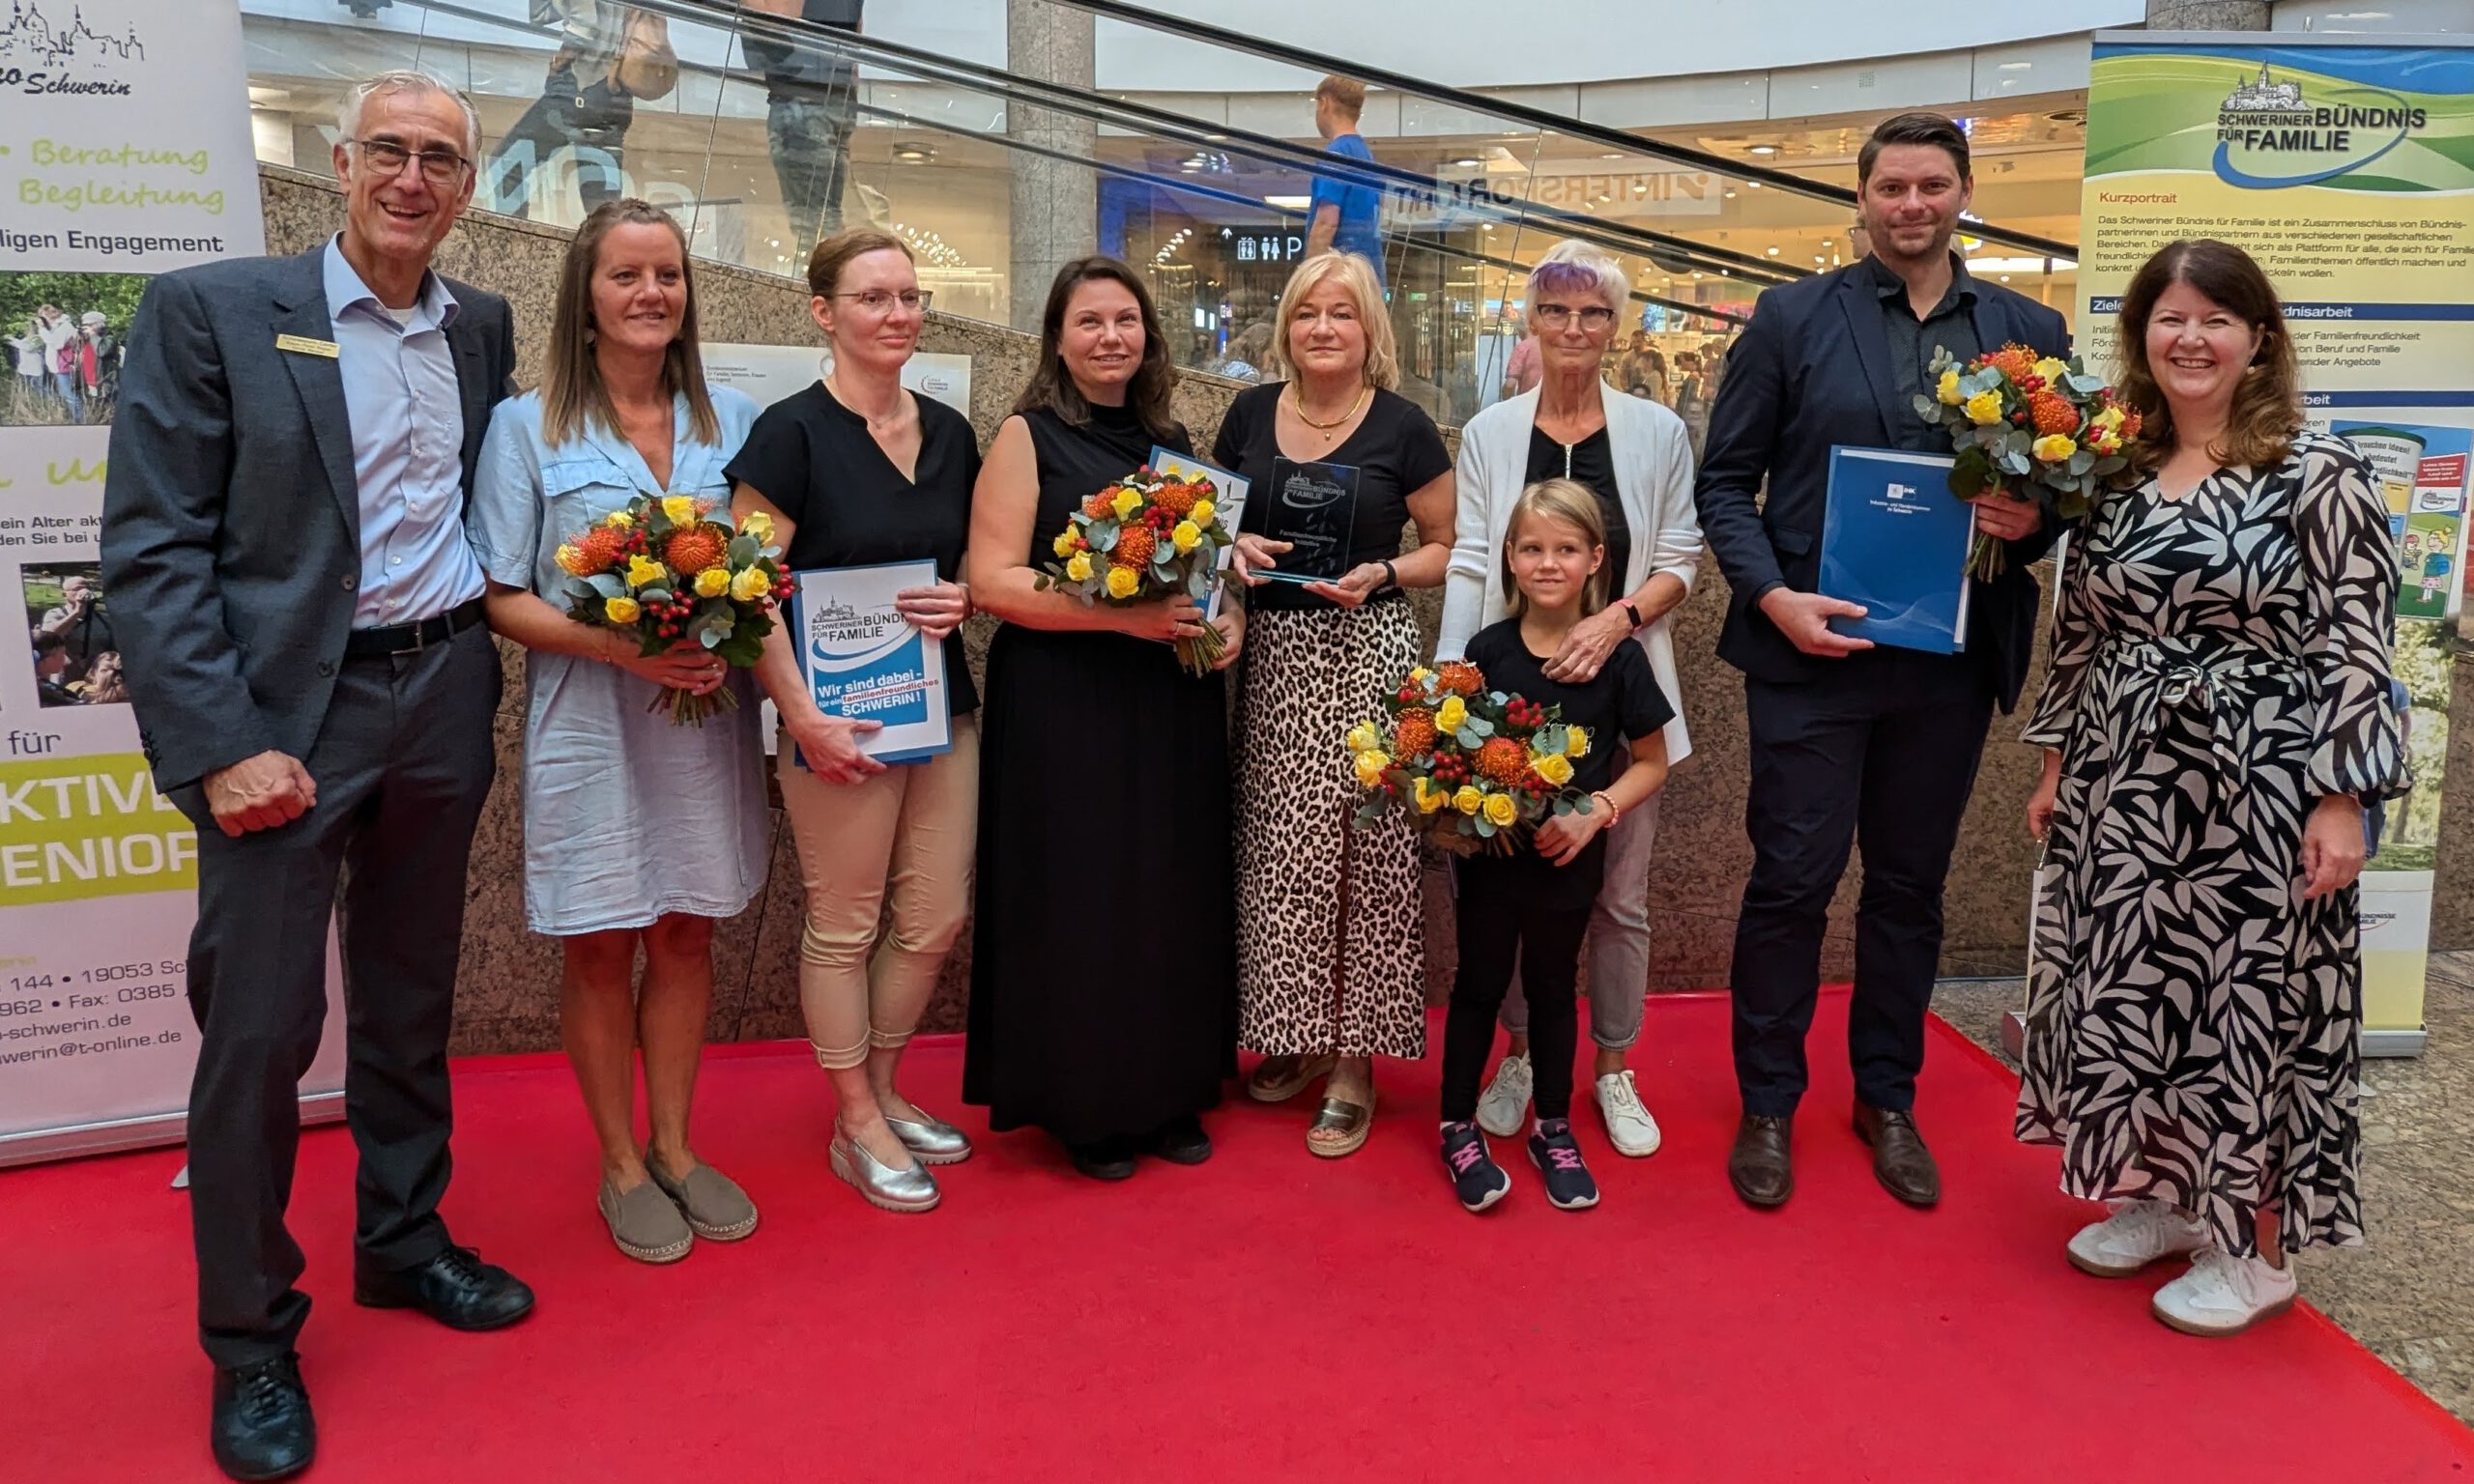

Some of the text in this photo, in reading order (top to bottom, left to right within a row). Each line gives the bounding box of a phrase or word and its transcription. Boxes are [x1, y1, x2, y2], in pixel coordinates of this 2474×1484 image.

[23, 72, 131, 96] Schwerin
[2218, 103, 2427, 128] SCHWERINER BÜNDNIS
[2217, 127, 2350, 151] FÜR FAMILIE
[31, 138, 210, 175] Beratung
[18, 178, 225, 215] Begleitung
[2099, 192, 2177, 205] Kurzportrait
[2098, 215, 2117, 225] Das
[2120, 215, 2174, 225] Schweriner
[2176, 216, 2214, 225] Bündnis
[2216, 217, 2229, 226] für
[2231, 217, 2265, 227] Familie
[2268, 218, 2281, 227] ist
[2284, 218, 2300, 227] ein
[2302, 218, 2397, 228] Zusammenschluss
[2420, 219, 2466, 229] Bündnis-
[67, 230, 224, 255] Engagement
[2097, 229, 2159, 238] partnerinnen
[2182, 229, 2259, 239] Bündnispartnern
[2285, 231, 2361, 240] verschiedenen
[2364, 232, 2453, 242] gesellschaftlichen
[1286, 237, 1303, 261] P
[2097, 240, 2148, 248] Bereichen.
[2254, 243, 2275, 251] sich
[2295, 243, 2344, 252] Plattform
[2345, 243, 2359, 253] für
[2384, 244, 2400, 253] die
[2402, 244, 2422, 254] sich
[2425, 245, 2439, 254] für
[2270, 255, 2352, 266] Familienthemen
[2355, 256, 2399, 266] öffentlich
[2402, 257, 2445, 267] machen
[2447, 258, 2466, 268] und
[2095, 264, 2133, 272] konkret
[2299, 270, 2335, 278] wollen.
[2314, 331, 2421, 341] Familienfreundlichkeit
[2316, 344, 2344, 354] Beruf
[2346, 345, 2365, 354] und
[2368, 345, 2401, 354] Familie
[2333, 357, 2381, 368] Angebote
[32, 516, 73, 528] Alter
[32, 532, 58, 545] Sie
[64, 531, 88, 544] bei
[812, 620, 863, 632] SCHWERINER
[812, 626, 884, 642] FÜR FAMILIE
[818, 684, 842, 699] Wir
[846, 676, 875, 694] sind
[877, 669, 914, 687] dabei
[819, 699, 830, 709] für
[843, 678, 939, 703] familienfreundliches
[8, 730, 61, 755] für
[11, 974, 54, 991] 144
[82, 963, 154, 984] 19053
[0, 999, 43, 1016] 962
[70, 994, 109, 1009] Fax:
[118, 984, 176, 1003] 0385
